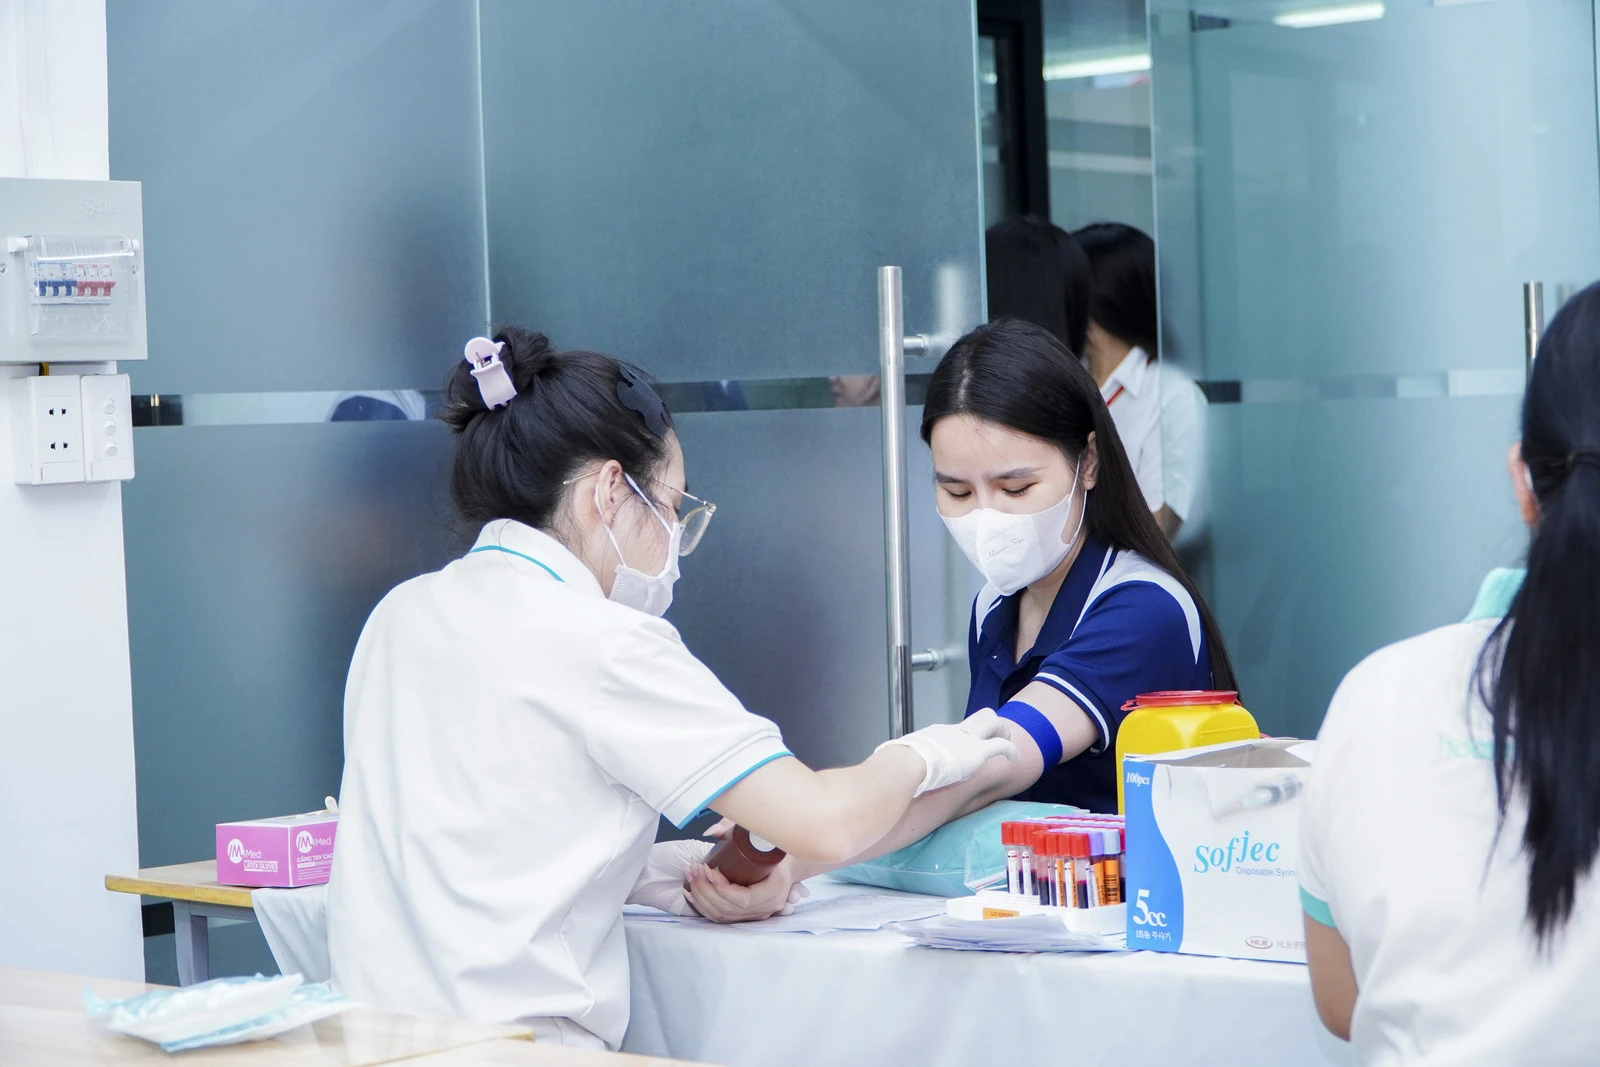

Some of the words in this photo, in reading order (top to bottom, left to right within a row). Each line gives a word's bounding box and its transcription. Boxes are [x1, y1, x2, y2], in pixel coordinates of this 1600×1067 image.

[1126, 772, 1150, 787] 100pcs
[1193, 830, 1280, 874] Sofjec
[1236, 866, 1275, 877] Disposable
[1133, 889, 1168, 927] 5cc
